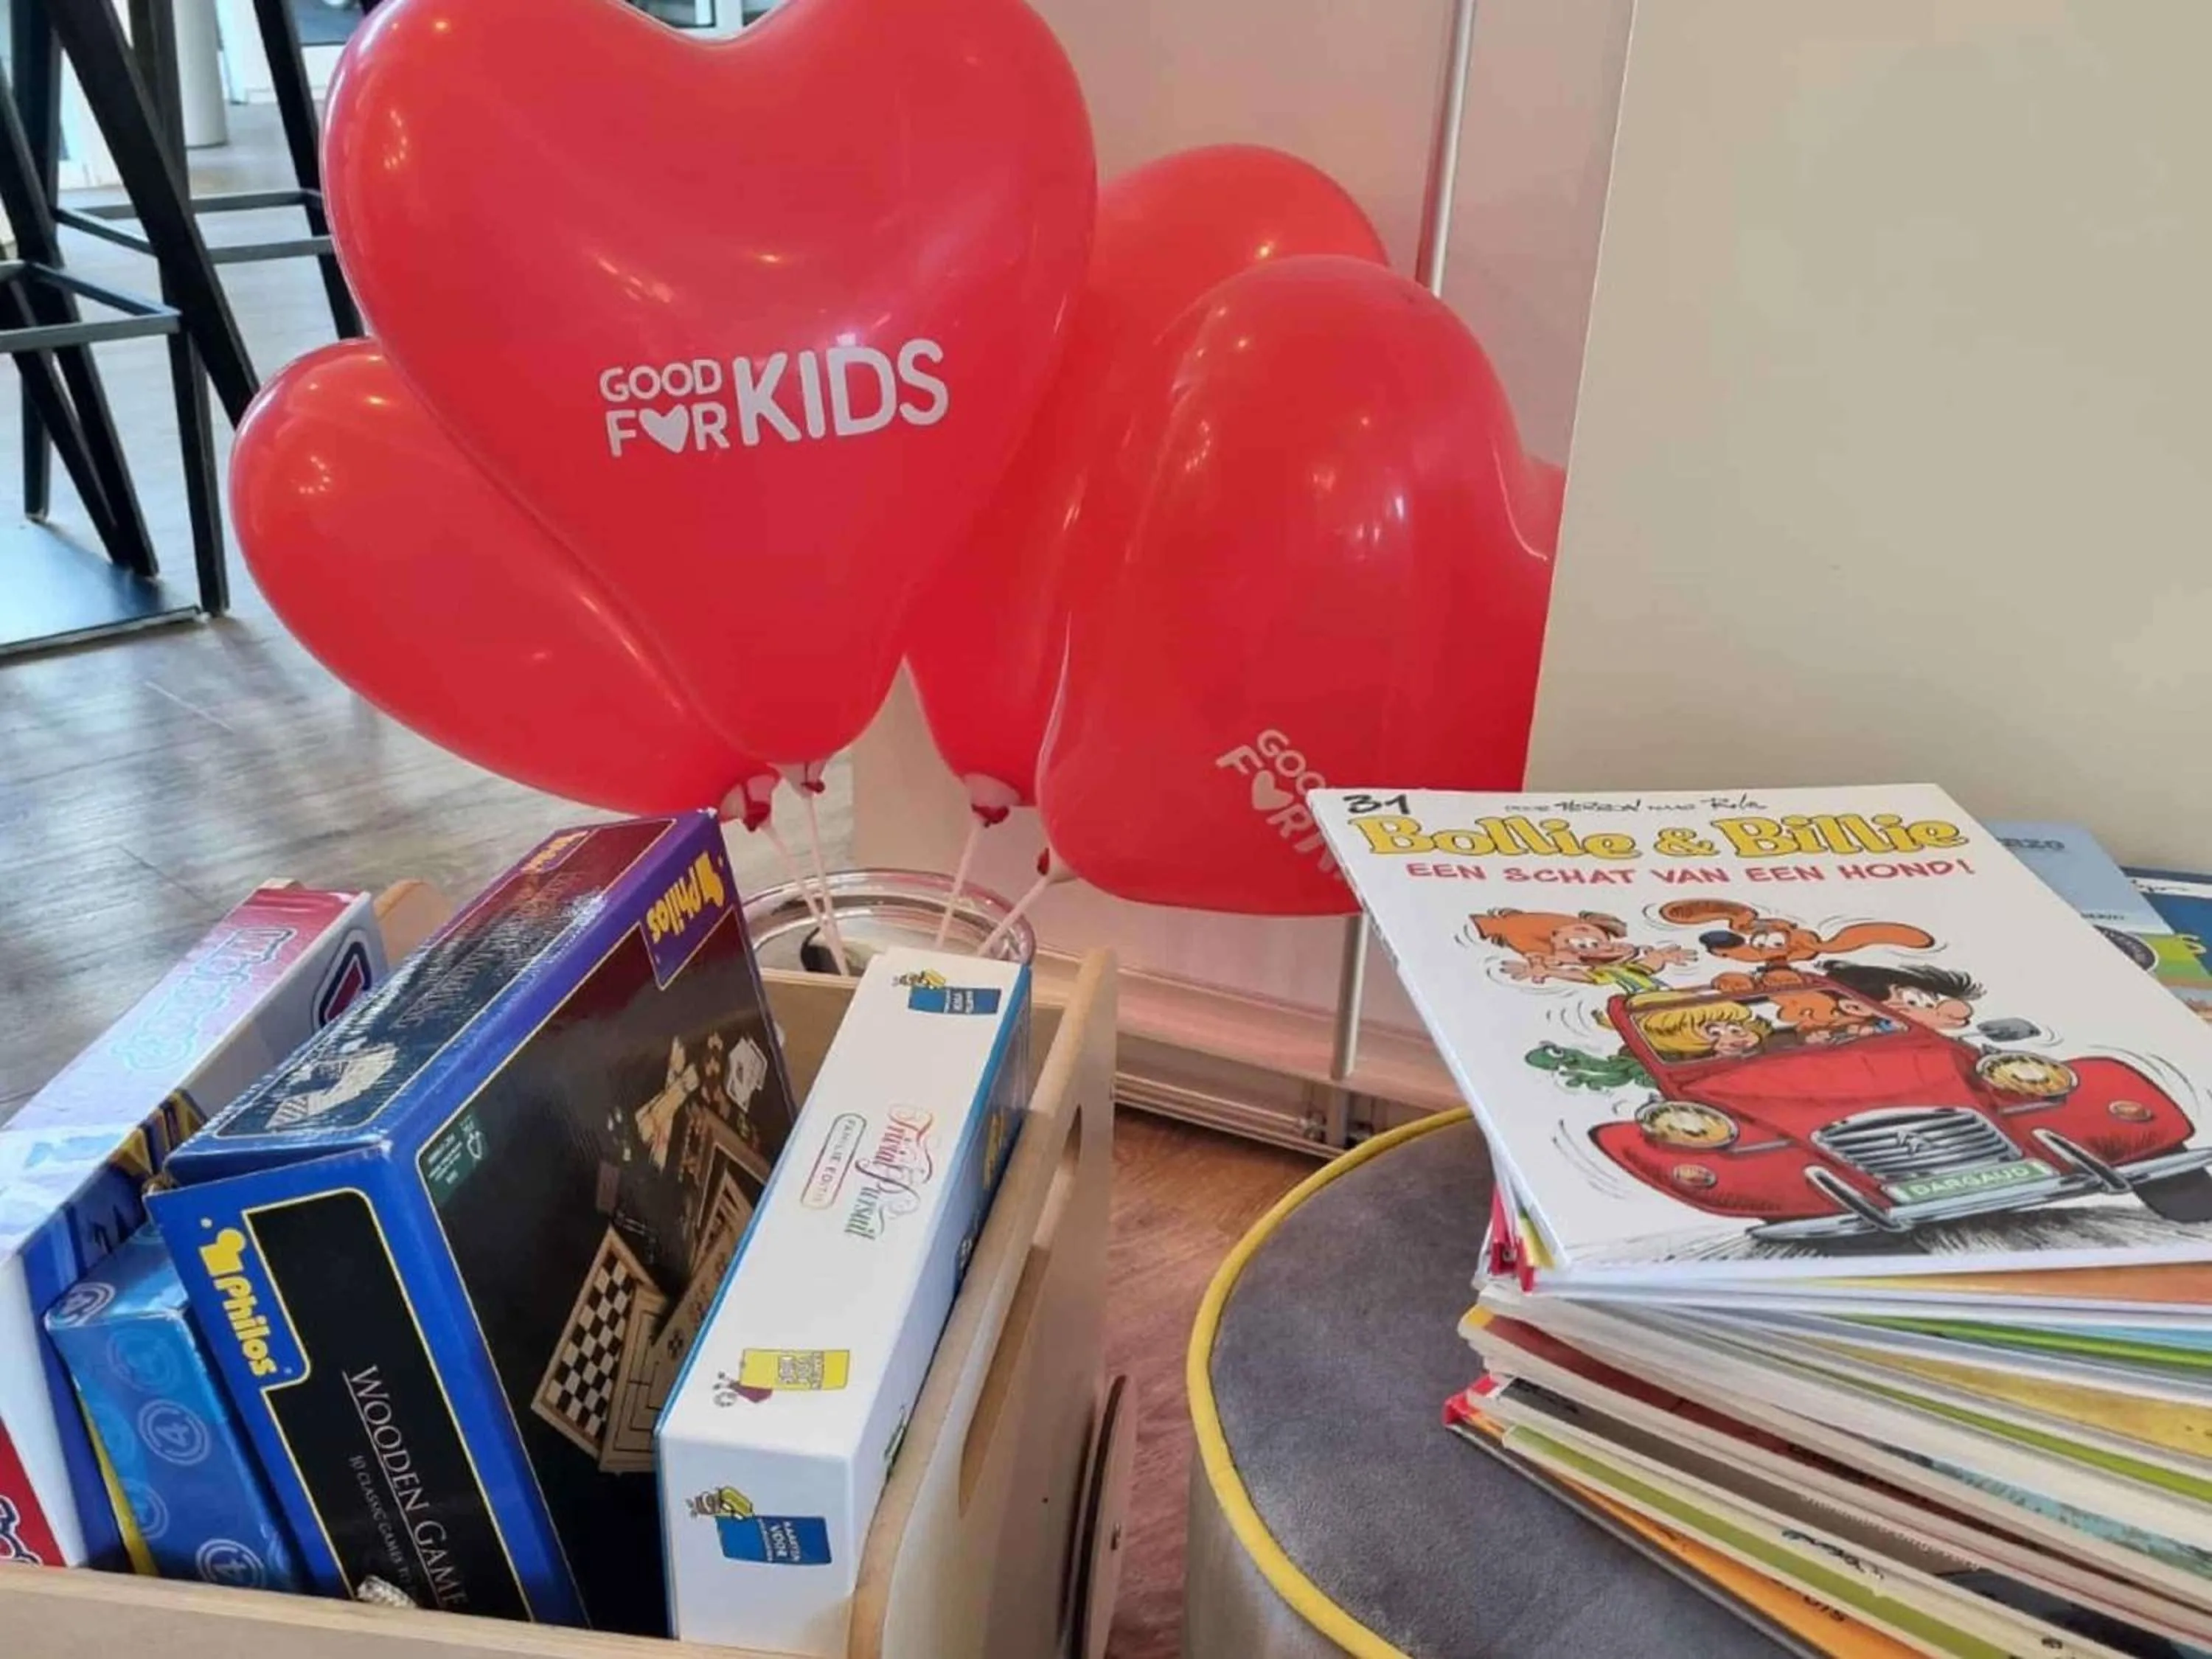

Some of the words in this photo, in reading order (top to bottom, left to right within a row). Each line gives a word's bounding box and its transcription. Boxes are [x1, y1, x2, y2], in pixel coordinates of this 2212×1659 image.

[599, 359, 723, 402] GOOD
[733, 338, 949, 446] KIDS
[1256, 728, 1326, 796] GOO
[1343, 793, 1411, 815] 31
[1348, 815, 1642, 860] Bollie
[1653, 827, 1721, 857] &
[1710, 813, 1969, 858] Billie
[1405, 863, 1488, 880] EEN
[1503, 867, 1637, 885] SCHAT
[1650, 868, 1731, 885] VAN
[1746, 866, 1825, 882] EEN
[1837, 858, 1976, 880] HOND!
[646, 866, 701, 945] Philos
[1908, 1167, 2031, 1196] DARGAUD
[214, 1275, 278, 1378] Philos
[349, 1365, 430, 1512] WOODEN
